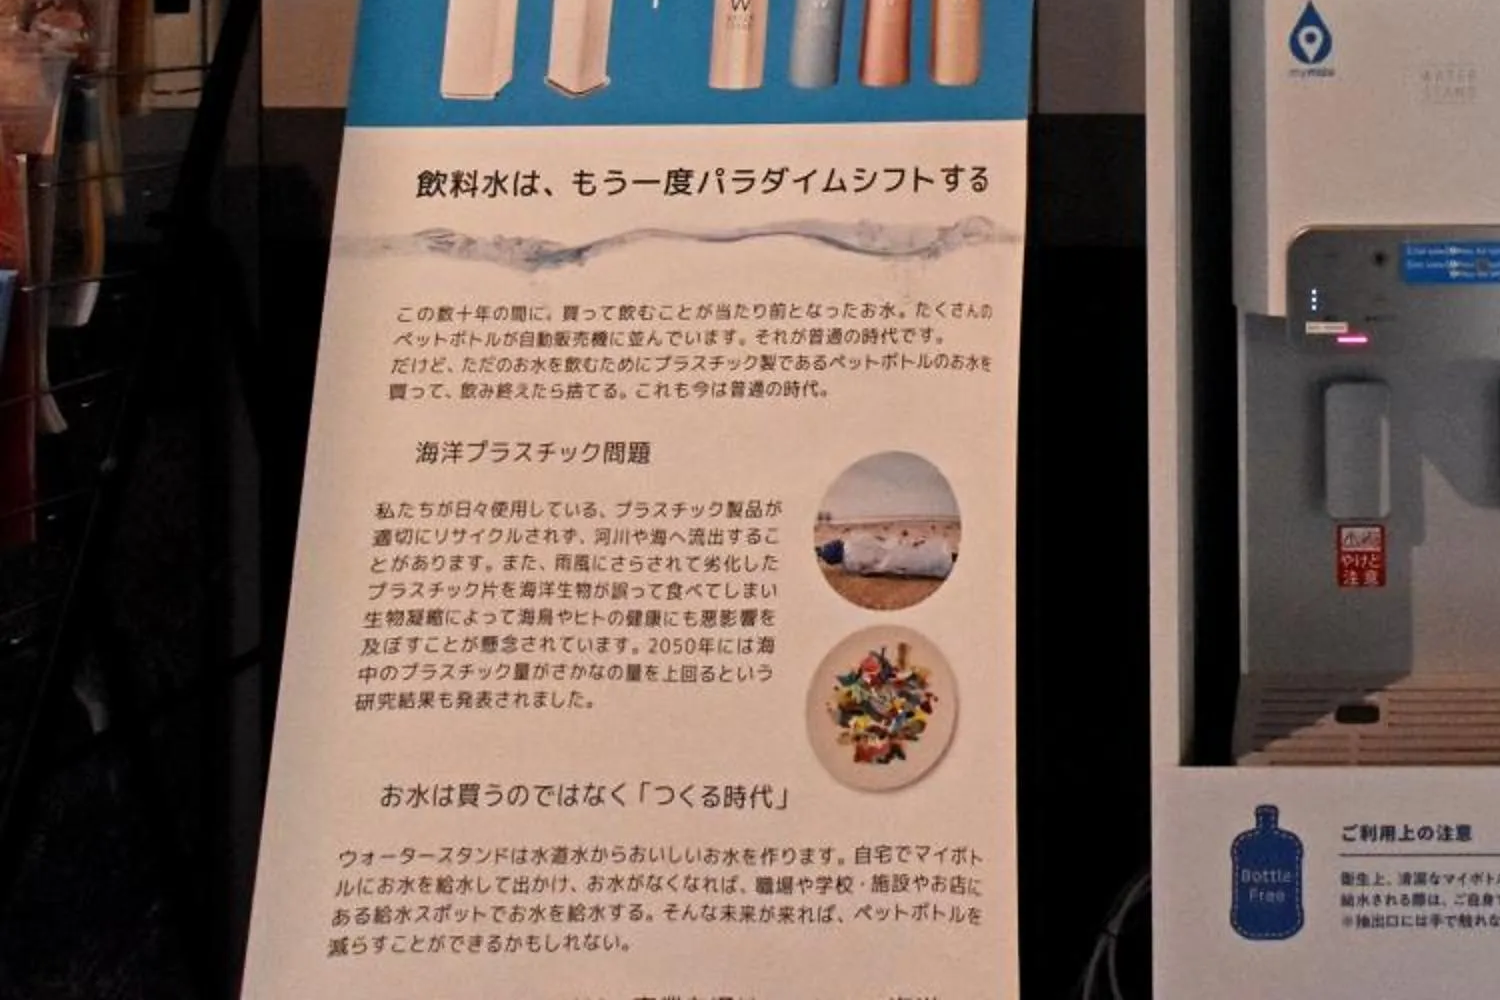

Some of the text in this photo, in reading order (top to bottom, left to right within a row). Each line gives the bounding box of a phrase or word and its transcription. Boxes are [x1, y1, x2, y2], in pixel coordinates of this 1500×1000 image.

[416, 165, 988, 198] 飲料水は、もう一度パラダイムシフトする
[416, 440, 650, 464] 海洋プラスチック問題
[375, 500, 782, 520] 私たちが日々使用している、プラスチック製品が
[370, 554, 778, 574] とがあります。また、雨風にさらされて劣化した
[1342, 553, 1380, 568] やけど
[369, 580, 777, 600] プラスチック片を海洋生物が誤って食べてしまい
[358, 662, 772, 684] 中のプラスチック量がさかなの量を上回るという
[355, 690, 592, 711] 研究結果も発表されました。
[381, 781, 787, 810] お水は買うのではなく「つくる時代」
[1342, 824, 1472, 842] ご利用上の注意
[327, 933, 629, 958] 減らすことができるかもしれない。
